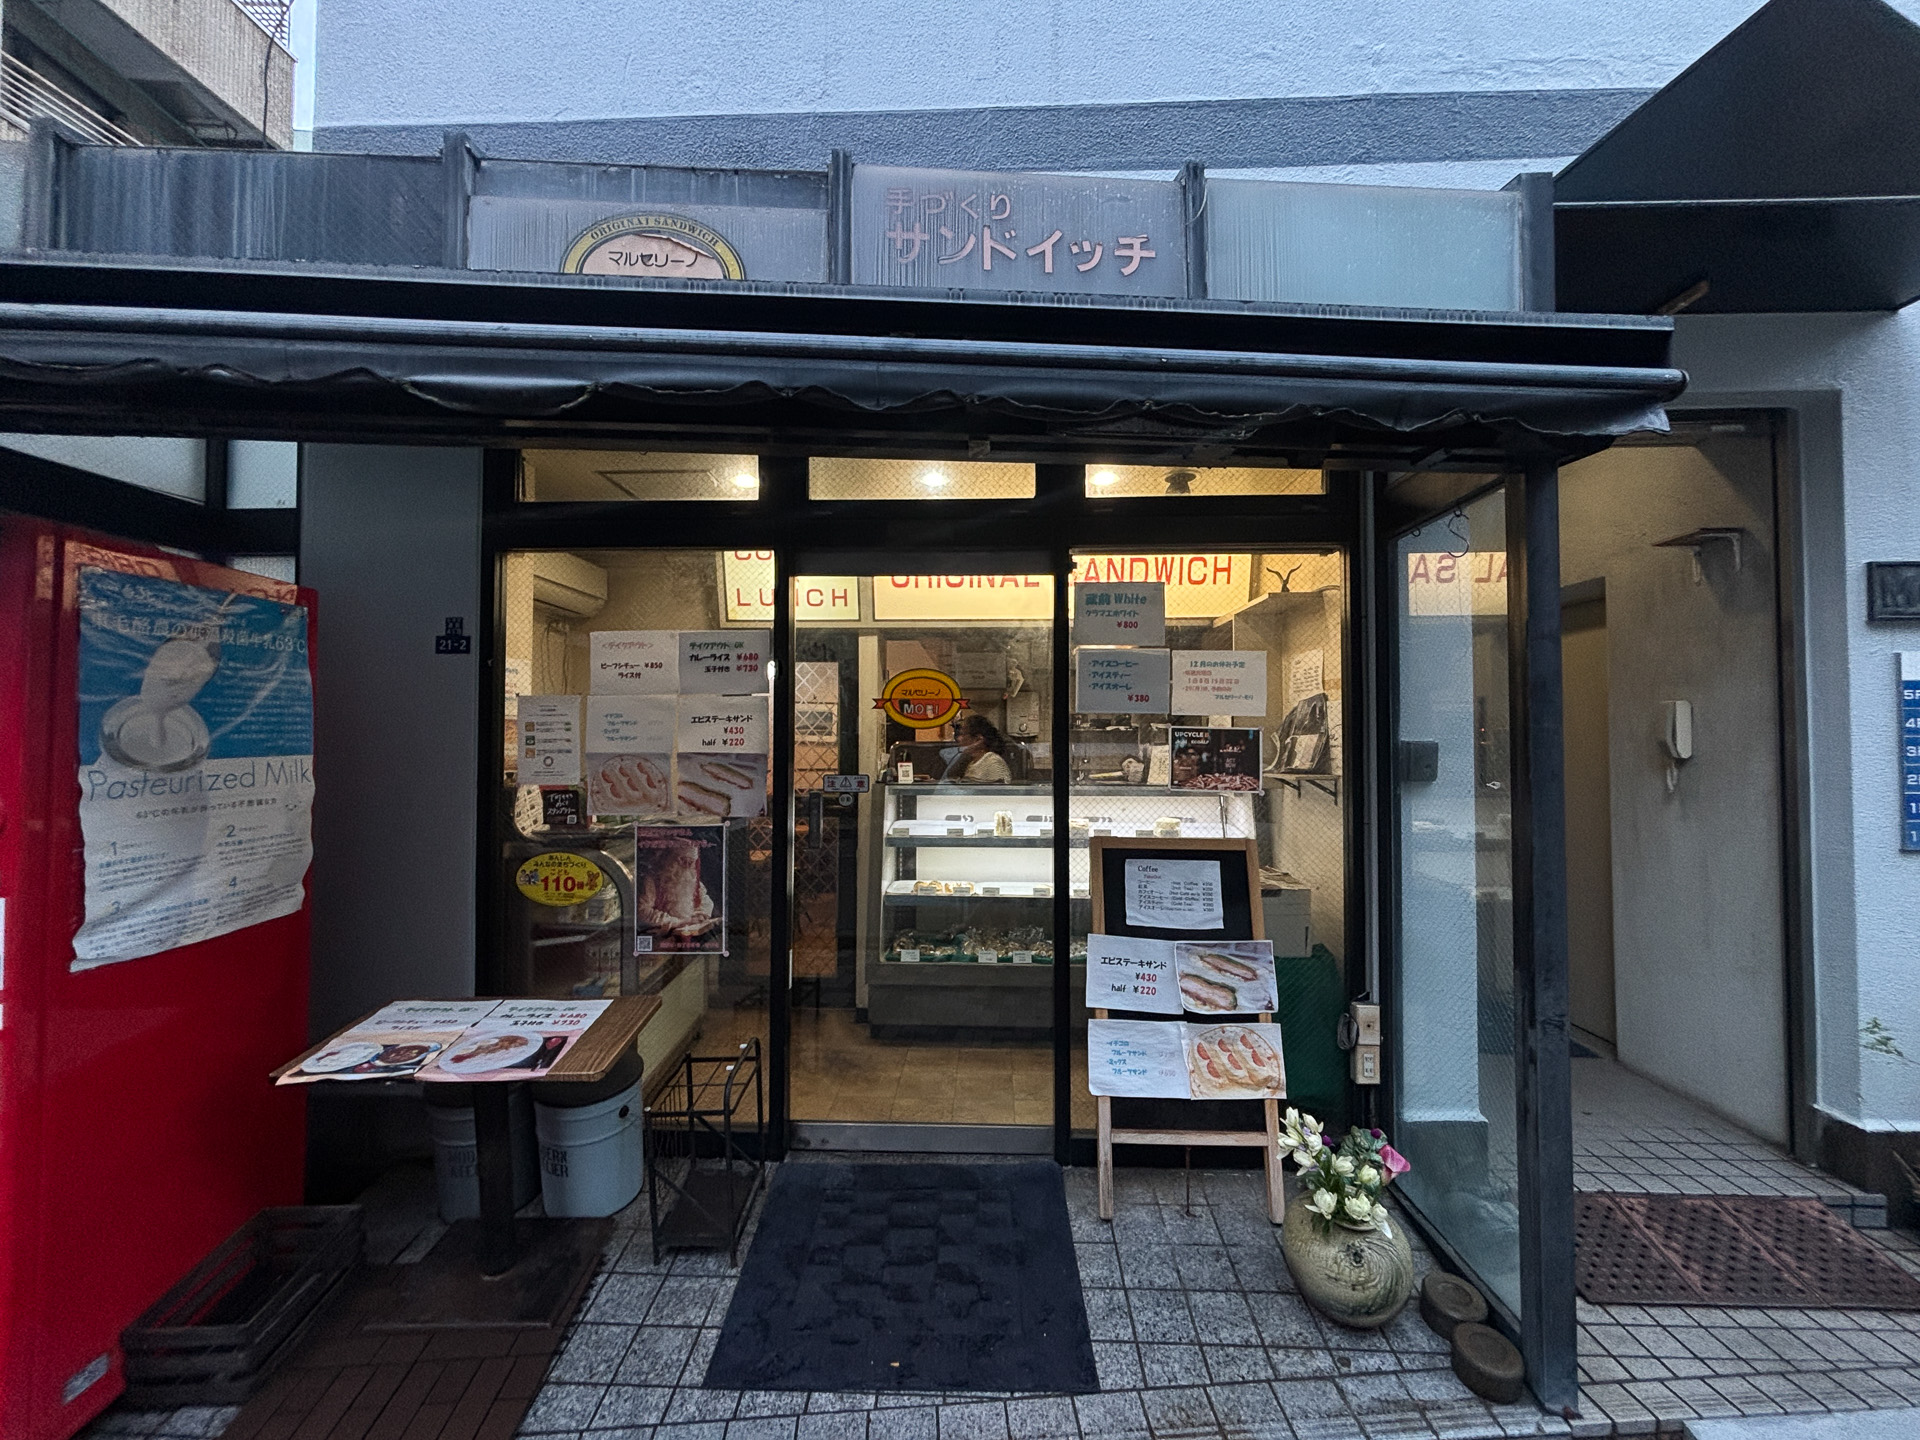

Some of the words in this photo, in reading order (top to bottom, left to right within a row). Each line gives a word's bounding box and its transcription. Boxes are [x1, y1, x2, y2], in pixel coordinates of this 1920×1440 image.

[888, 188, 1011, 220] 手づくり
[590, 217, 650, 241] ORIGINAL
[653, 216, 720, 248] SANDWICH
[886, 222, 1156, 276] サンドイッチ
[608, 250, 698, 268] マルセリーノ
[1070, 556, 1232, 586] ANDWICH
[1113, 592, 1147, 605] White
[1117, 621, 1139, 629] ¥800
[439, 639, 467, 650] 21-2
[689, 653, 731, 661] カレーライス
[901, 688, 941, 697] マルセリーノ
[1127, 694, 1150, 702] ¥380
[690, 714, 753, 724] エビステーキサンド
[723, 726, 745, 735] ¥430
[701, 738, 717, 746] half
[722, 738, 745, 746] ¥220
[87, 762, 255, 801] Pasteurized
[264, 759, 312, 786] Milk
[226, 825, 236, 838] 2
[110, 841, 118, 856] 1
[1137, 864, 1158, 872] Coffee
[228, 876, 237, 888] 4
[111, 901, 121, 916] 3
[1100, 955, 1168, 969] エビステーキサンド
[1135, 972, 1157, 983] ¥430
[1111, 984, 1127, 993] half
[1132, 985, 1157, 996] ¥220
